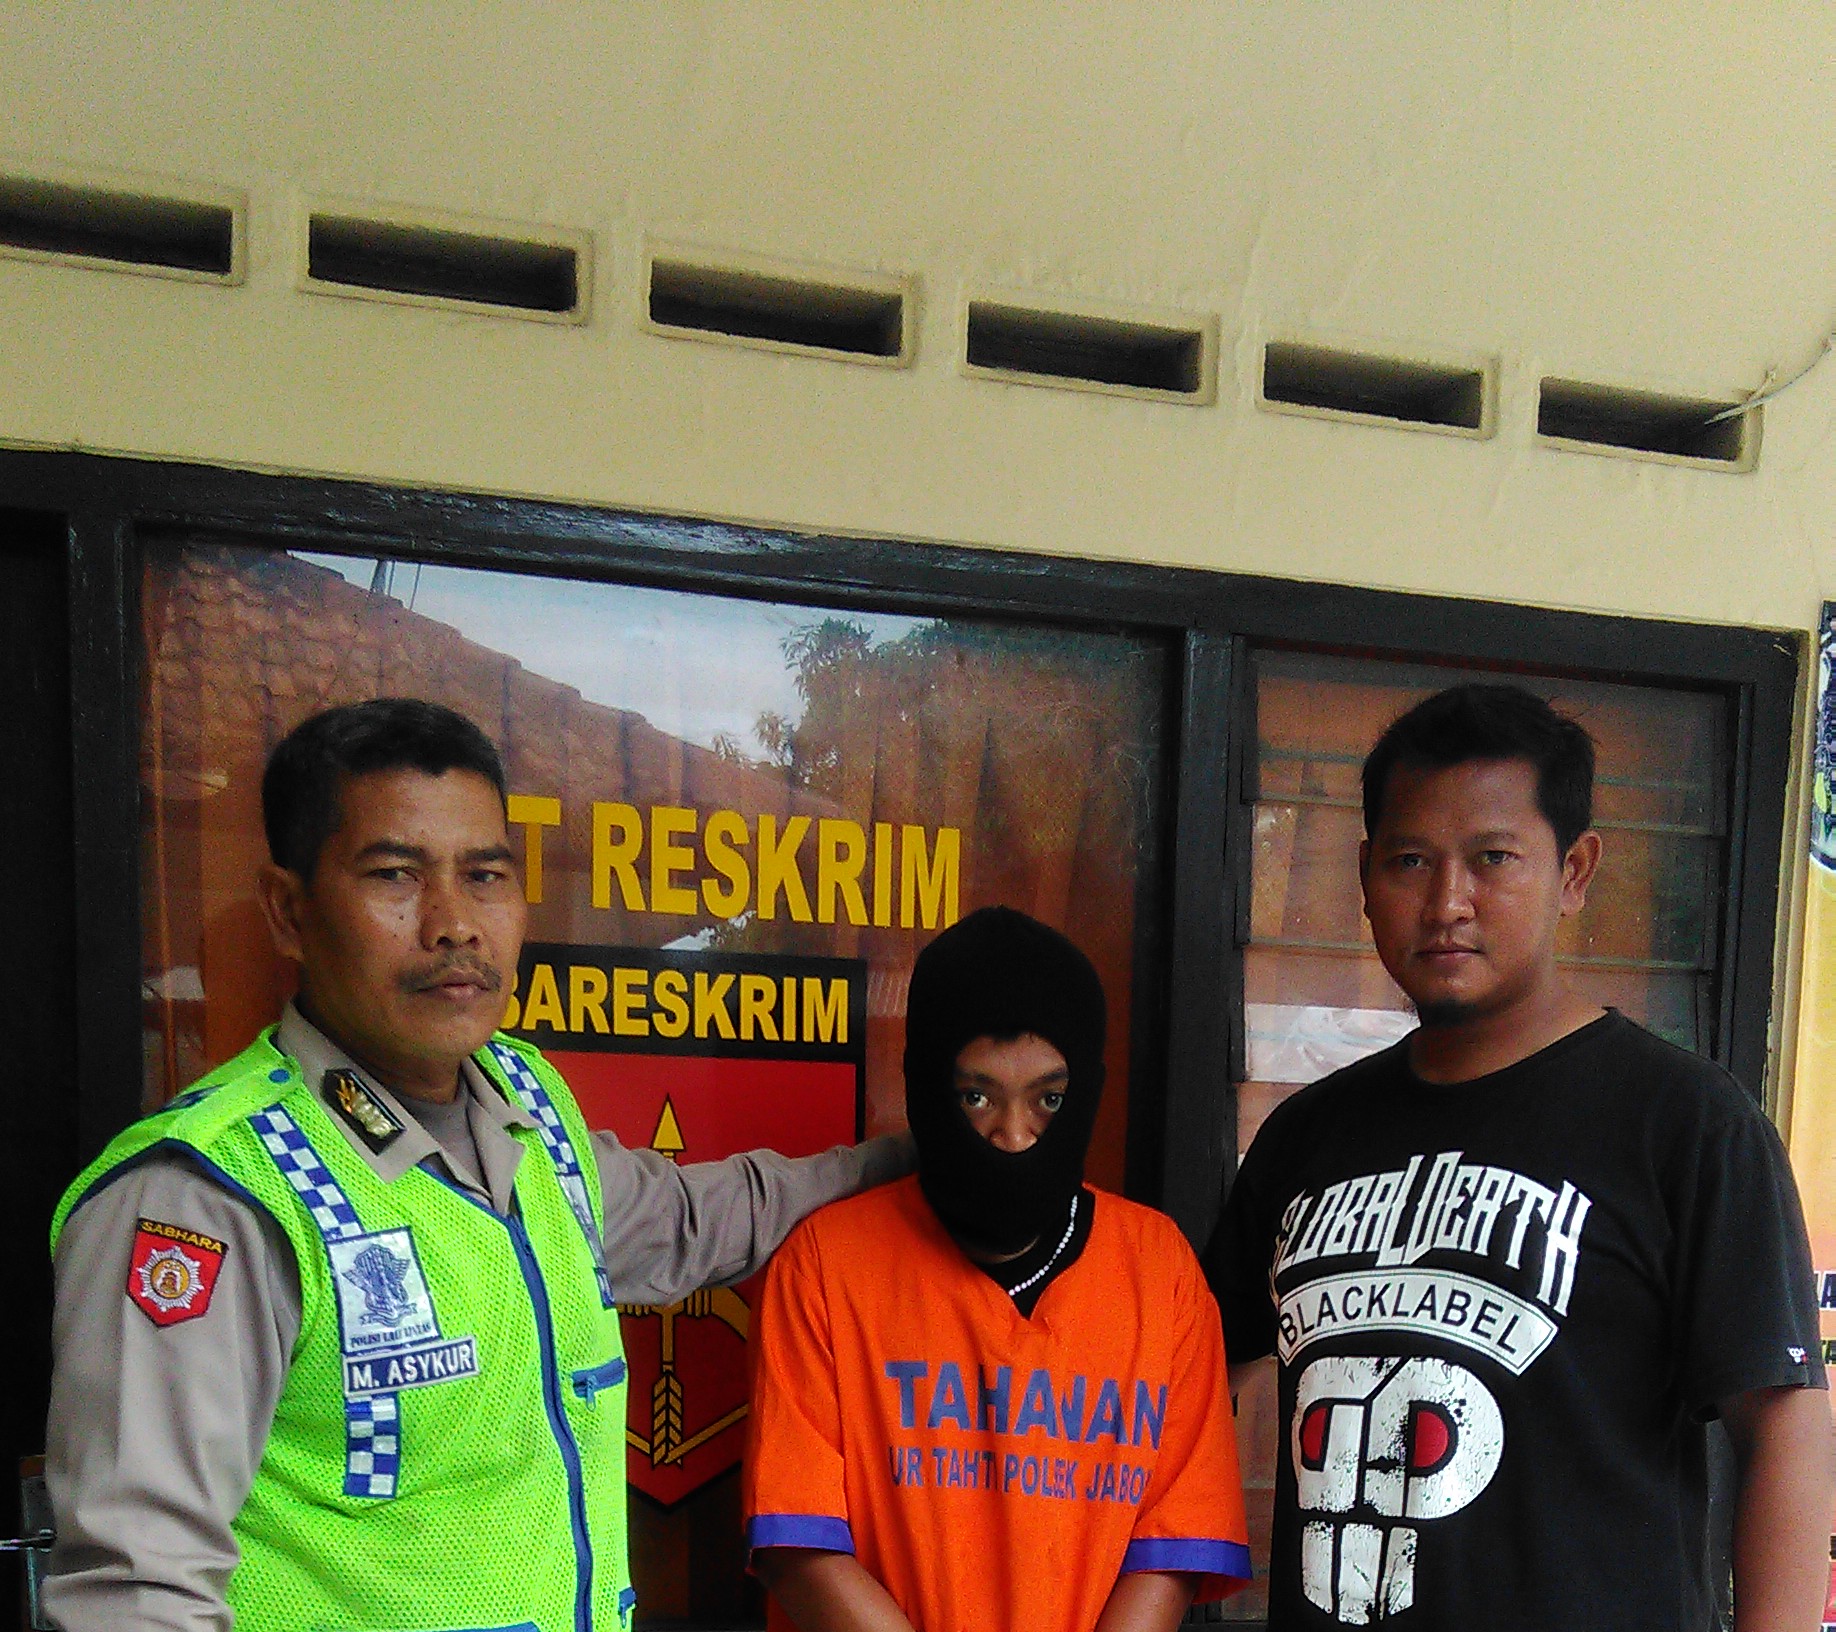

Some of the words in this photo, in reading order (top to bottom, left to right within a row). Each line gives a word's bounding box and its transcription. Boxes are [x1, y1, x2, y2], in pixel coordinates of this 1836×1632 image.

[592, 802, 961, 930] RESKRIM
[141, 1221, 223, 1254] SABHARA
[1279, 1282, 1518, 1353] BLACKLABEL
[352, 1364, 380, 1389] M.
[387, 1344, 473, 1385] ASYKUR
[1084, 1463, 1153, 1506] JABO
